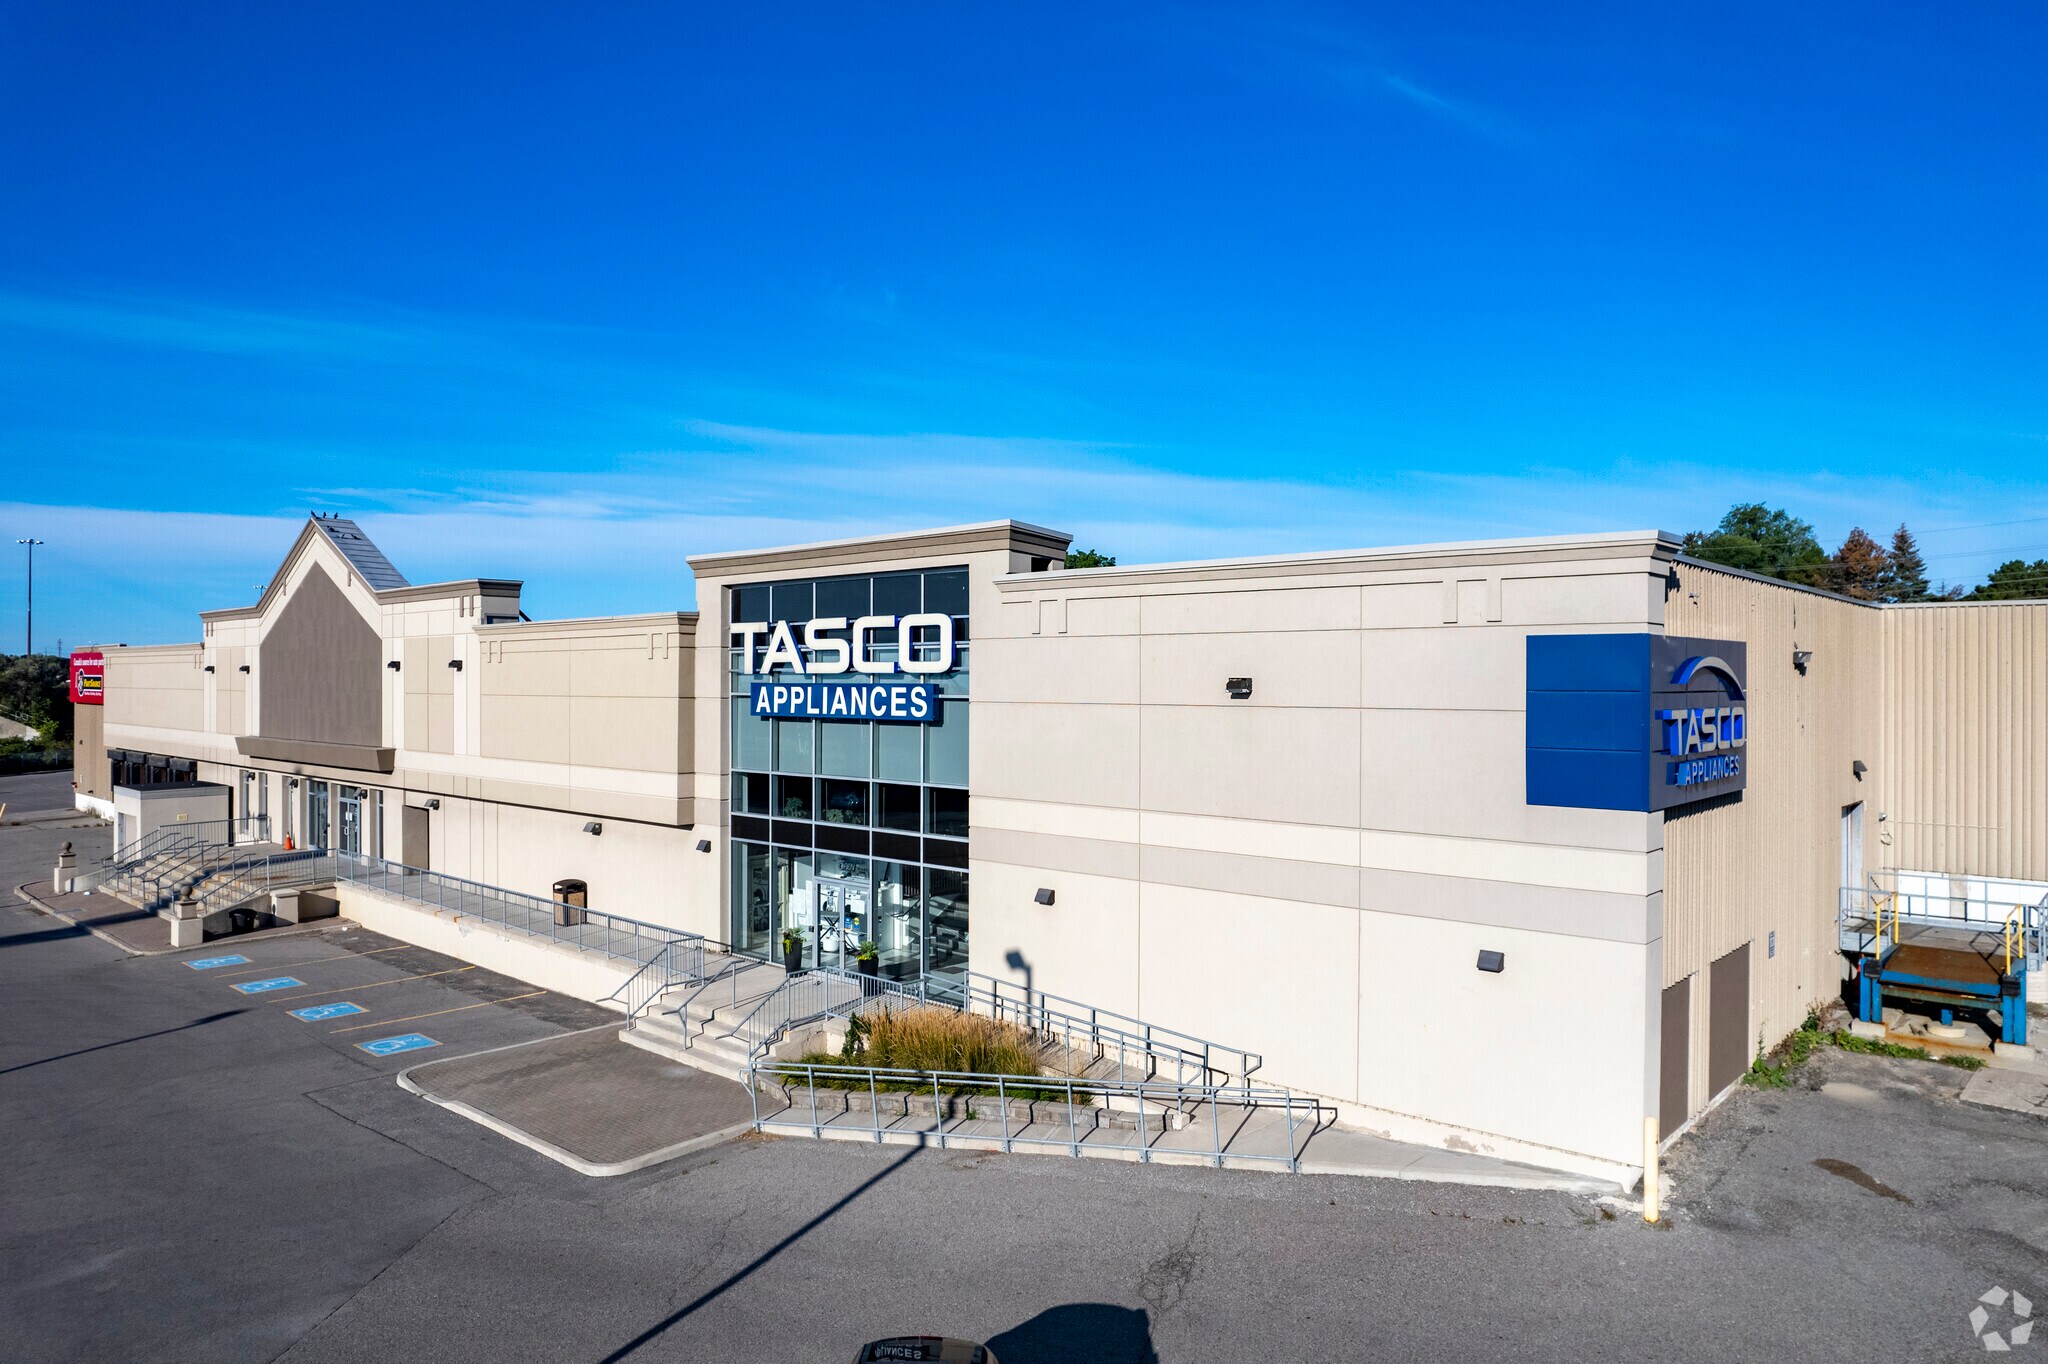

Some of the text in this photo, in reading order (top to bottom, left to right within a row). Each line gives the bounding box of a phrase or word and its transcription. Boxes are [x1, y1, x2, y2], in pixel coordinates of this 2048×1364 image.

[730, 613, 954, 674] TASCO
[755, 686, 928, 717] APPLIANCES
[1664, 706, 1746, 756] TASCO
[1685, 755, 1740, 785] APPLIANCES
